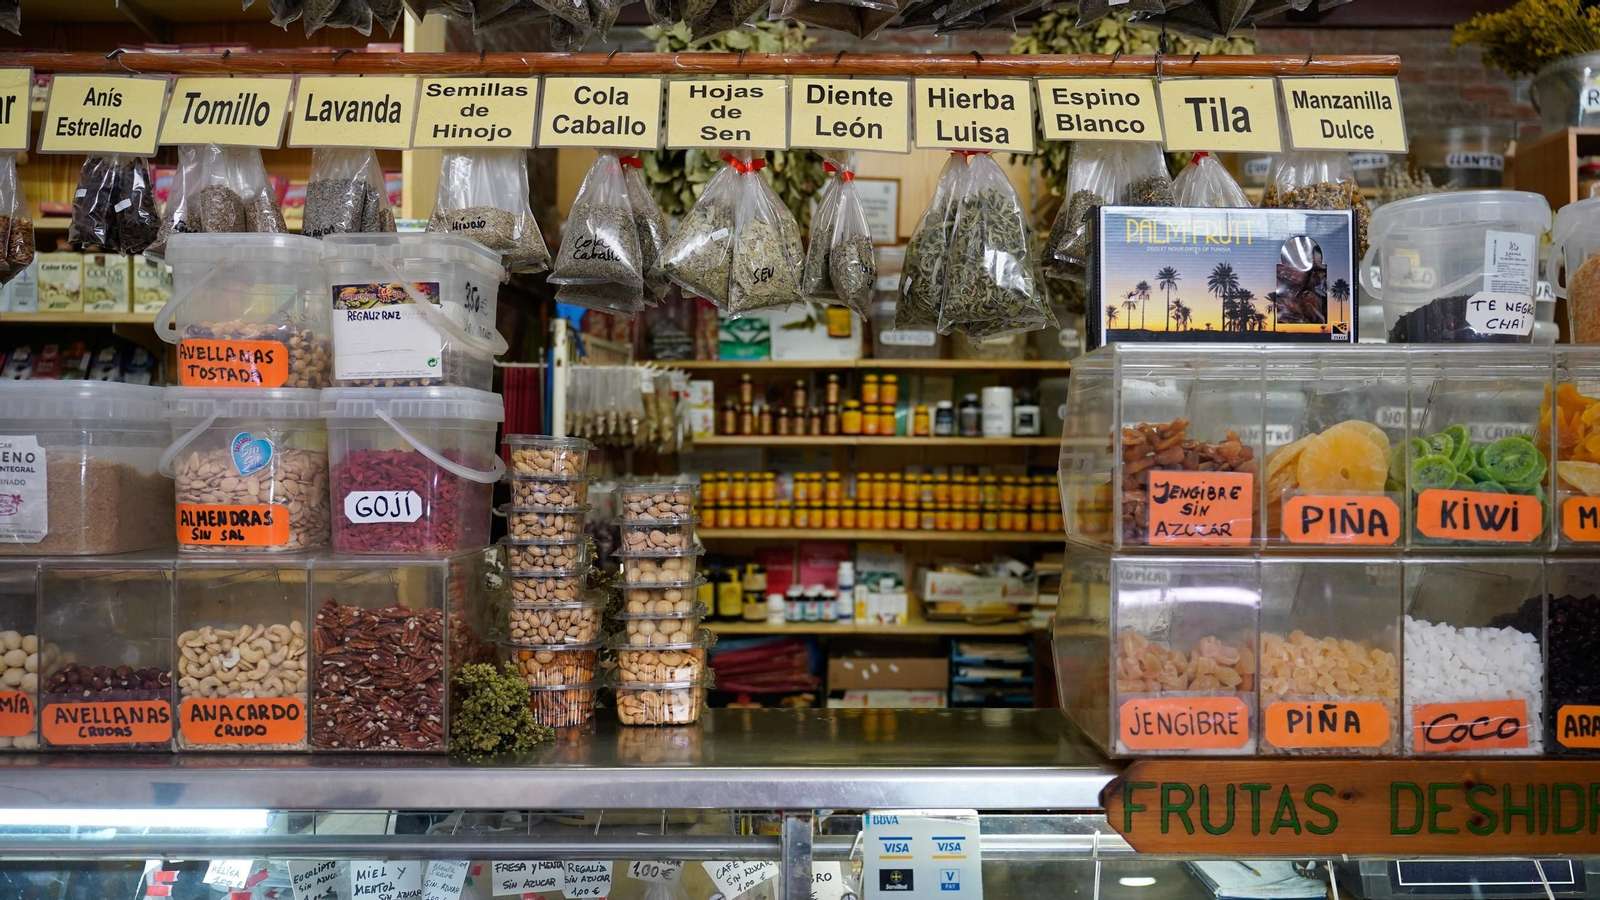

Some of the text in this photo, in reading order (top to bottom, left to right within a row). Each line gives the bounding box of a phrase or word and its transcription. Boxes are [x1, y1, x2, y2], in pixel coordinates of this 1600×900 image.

[83, 87, 122, 107] Anís
[425, 83, 528, 97] Semillas
[574, 86, 629, 105] Cola
[689, 85, 764, 100] Hojas
[806, 85, 893, 107] Diente
[1053, 88, 1140, 109] Espino
[928, 88, 1015, 111] Hierba
[1292, 91, 1393, 110] Manzanilla
[0, 95, 17, 125] r
[182, 92, 271, 127] Tomillo
[304, 93, 401, 124] Lavanda
[460, 103, 489, 118] de
[710, 105, 742, 119] de
[1185, 98, 1252, 133] Tila
[56, 117, 142, 139] Estrellado
[433, 124, 512, 141] Hinojo
[552, 115, 647, 136] Caballo
[815, 116, 883, 139] León
[937, 120, 1010, 144] Luisa
[1056, 114, 1145, 134] Blanco
[1321, 119, 1374, 140] Dulce
[700, 126, 751, 141] Sen
[575, 233, 610, 249] Cola
[1470, 300, 1534, 316] TE NEGR
[1486, 316, 1524, 330] CHAI
[179, 343, 274, 364] AVELLANAS
[188, 364, 263, 383] TOSTADA
[2, 451, 36, 464] ENO
[1153, 481, 1242, 505] JENGIBRE
[1180, 501, 1210, 517] SIN
[1441, 497, 1519, 532] KIWI
[180, 509, 273, 527] ALMENDRAS
[1302, 502, 1389, 537] PIÑA
[190, 527, 245, 541] SIN SAL
[55, 706, 170, 725] AVELLANAS
[191, 704, 300, 722] ANACARDO
[1287, 704, 1361, 734] PIÑA
[214, 724, 267, 737] CRUDO
[1129, 707, 1239, 737] JENGIBRE
[78, 725, 133, 738] CRUDAS
[1123, 782, 1339, 836] FRUTAS
[873, 815, 899, 825] BBVA
[883, 843, 909, 853] VISA
[938, 842, 962, 852] VISA
[356, 865, 407, 881] MIEL Y
[494, 862, 527, 873] FRESA
[660, 868, 676, 881] €
[945, 871, 955, 881] V
[502, 877, 556, 889] SIN AZUCAR
[564, 874, 611, 884] SIN AZUCAR
[726, 874, 741, 886] SIN
[811, 872, 833, 883] RO
[354, 881, 395, 896] MENTOL
[592, 886, 601, 895] €
